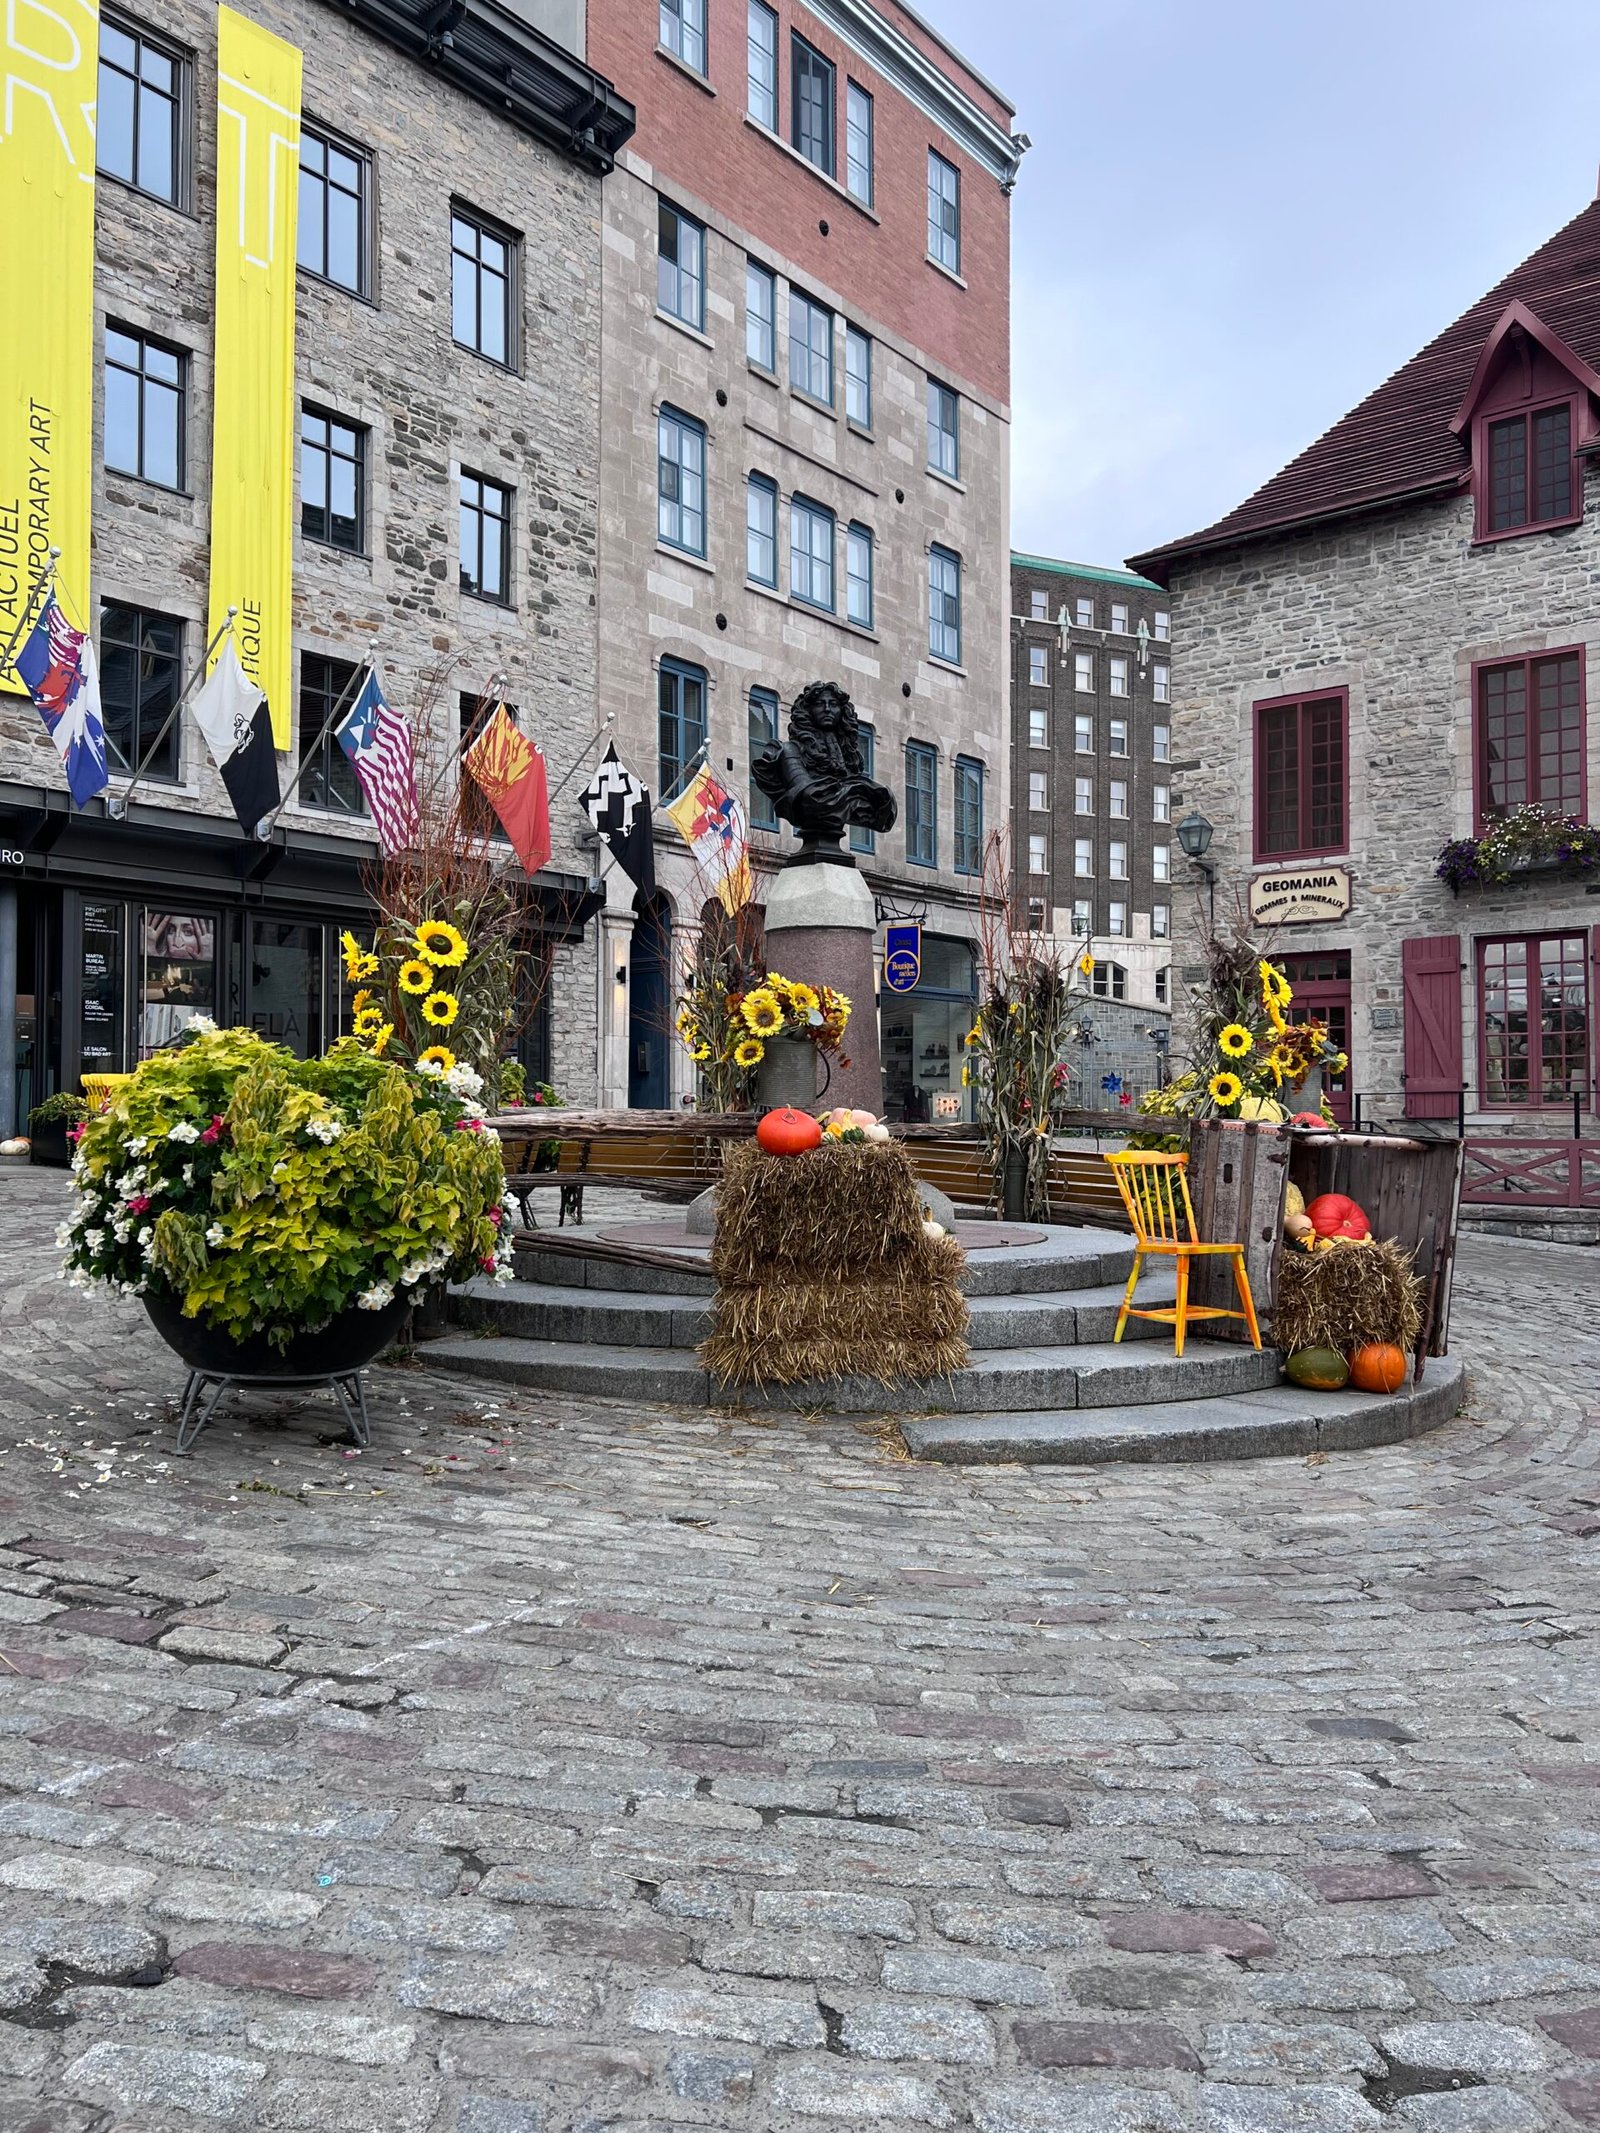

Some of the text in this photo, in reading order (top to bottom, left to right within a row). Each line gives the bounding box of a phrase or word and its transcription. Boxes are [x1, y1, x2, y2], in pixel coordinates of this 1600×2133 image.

[27, 397, 51, 631] TEMPORARY ART
[242, 597, 261, 688] TIQUE
[0, 849, 24, 864] RO
[1262, 876, 1338, 892] GEOMANIA
[1255, 896, 1288, 915] GEMMES
[1301, 894, 1345, 909] MINERAUX
